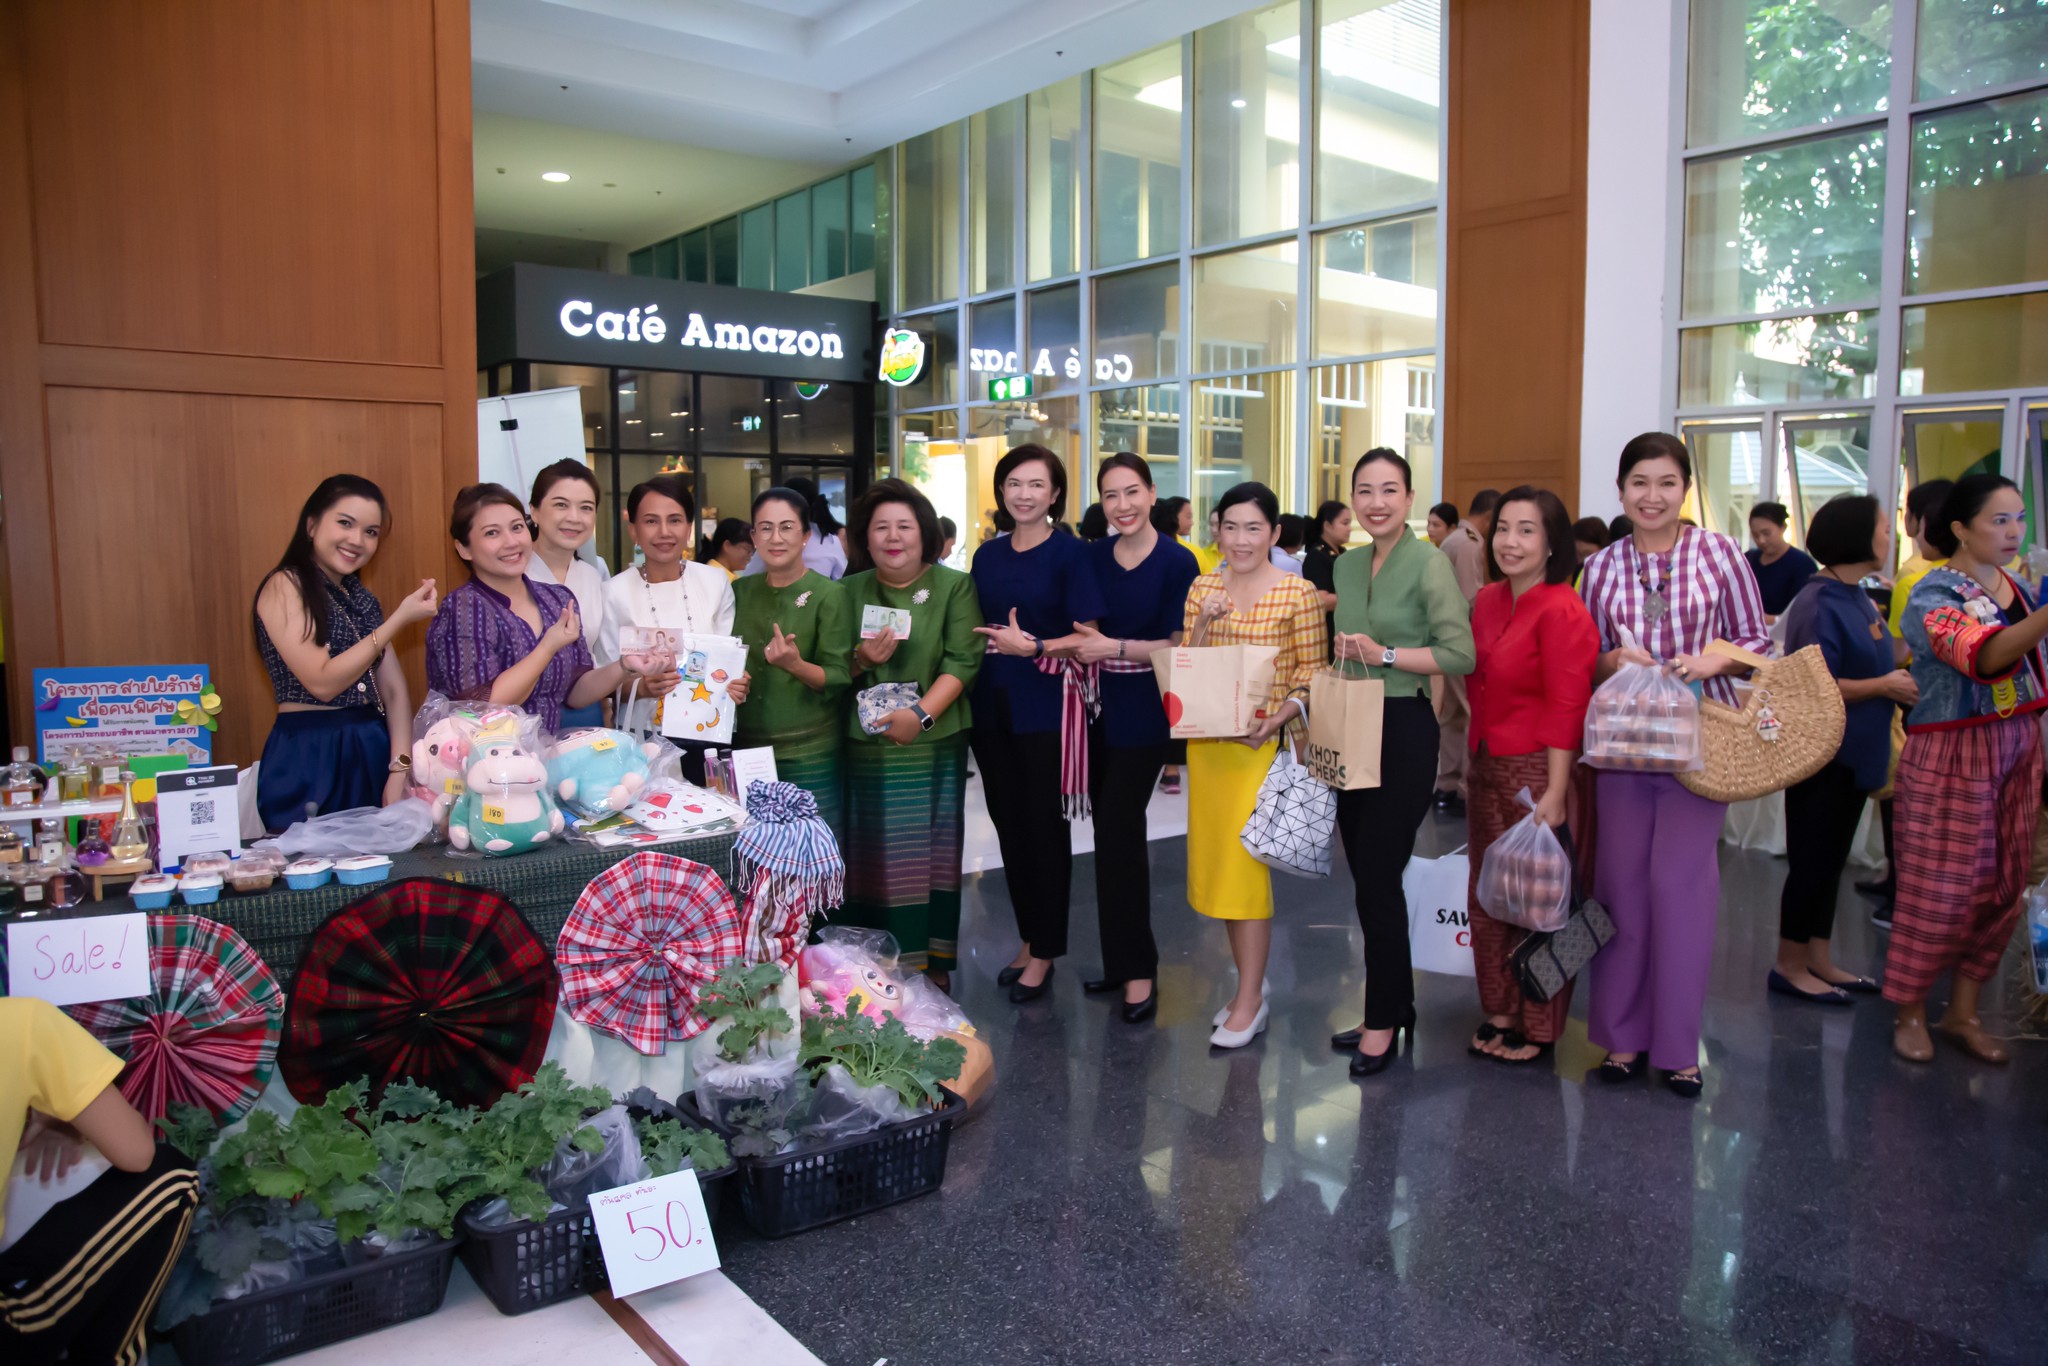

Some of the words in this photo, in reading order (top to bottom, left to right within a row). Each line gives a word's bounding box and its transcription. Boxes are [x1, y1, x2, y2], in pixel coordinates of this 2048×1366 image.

[560, 300, 667, 343] Café
[681, 313, 844, 359] Amazon
[489, 807, 502, 818] 180
[34, 923, 129, 981] Sale!
